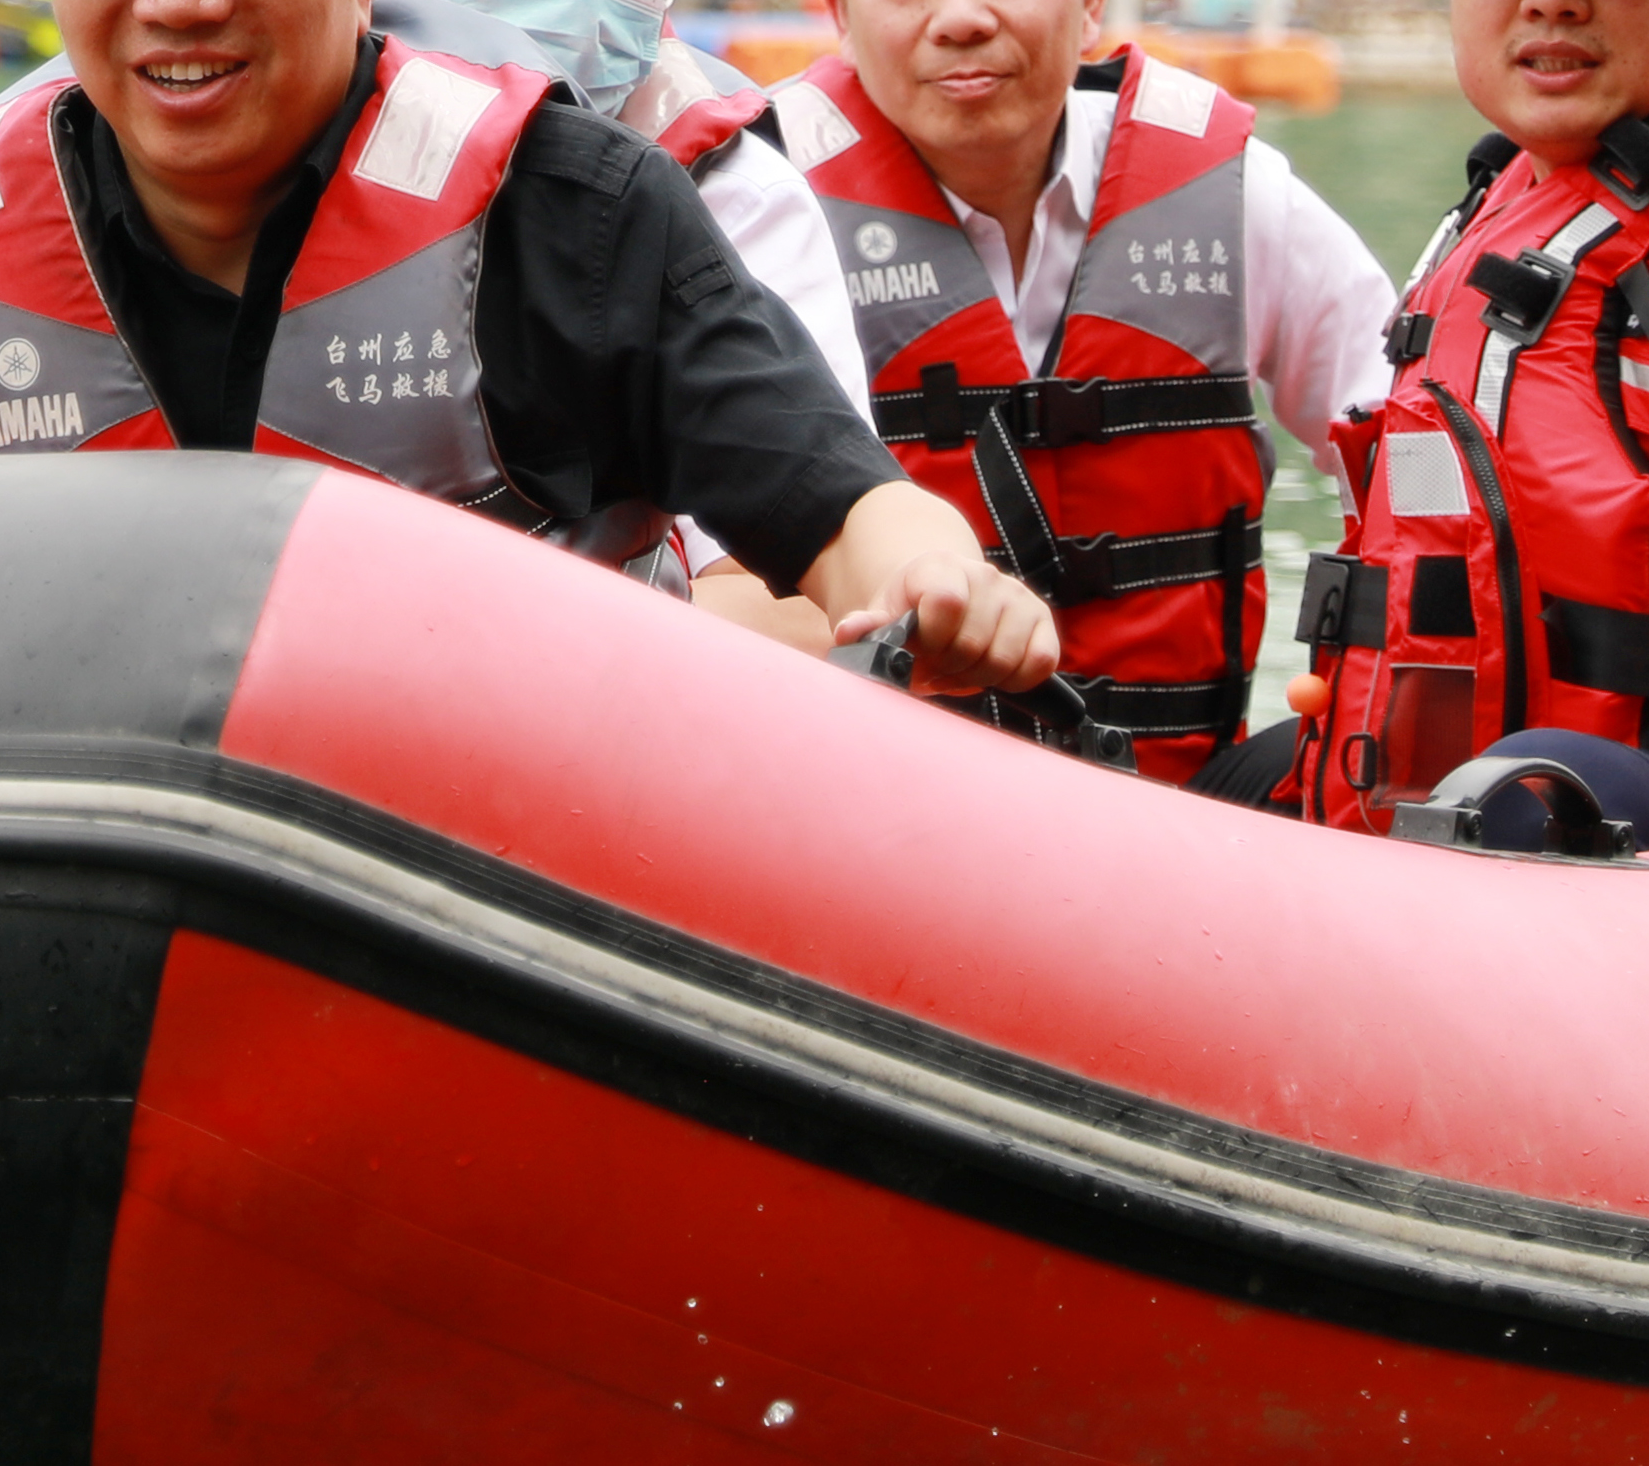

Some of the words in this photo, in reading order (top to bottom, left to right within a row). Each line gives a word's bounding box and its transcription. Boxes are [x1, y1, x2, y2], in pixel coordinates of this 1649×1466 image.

[1128, 238, 1229, 265] 台州应急
[847, 261, 940, 307] AMAHA
[326, 329, 451, 366] 台州应急
[325, 369, 454, 405] 飞马救援
